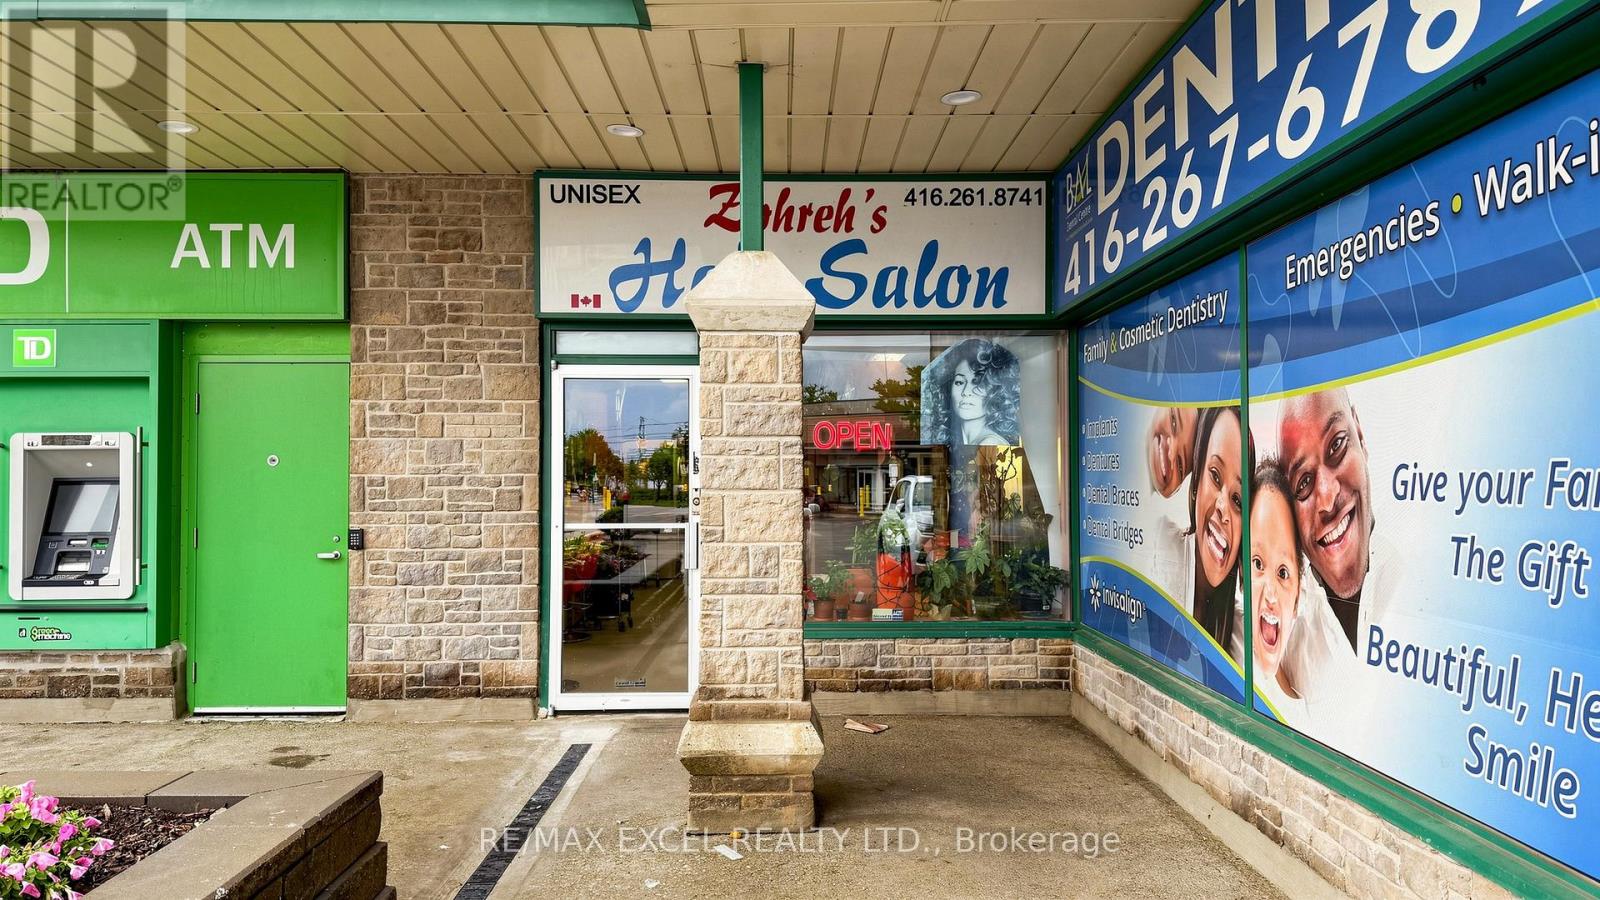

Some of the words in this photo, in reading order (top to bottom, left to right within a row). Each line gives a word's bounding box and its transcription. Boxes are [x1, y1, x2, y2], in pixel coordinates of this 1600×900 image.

[1064, 0, 1540, 296] 416-267-678
[550, 183, 641, 204] UNISEX
[904, 187, 1043, 206] 416.261.8741
[170, 223, 296, 269] ATM
[1285, 199, 1441, 291] Emergencies
[805, 238, 1009, 310] Salon
[17, 336, 52, 360] TD
[1083, 335, 1109, 363] Family
[1110, 332, 1117, 354] &
[1119, 312, 1164, 351] Cosmetic
[1167, 289, 1228, 333] Dentistry
[812, 420, 891, 450] OPEN
[1086, 452, 1120, 471] Dentures
[1086, 484, 1111, 506] Dental
[1112, 485, 1140, 507] Braces
[1392, 463, 1448, 502] Give
[1454, 470, 1534, 516] your
[1086, 516, 1111, 540] Dental
[1112, 517, 1144, 550] Bridges
[1450, 533, 1506, 584] The
[1516, 540, 1591, 608] Gift
[1365, 624, 1529, 724] Beautiful,
[1464, 724, 1580, 818] Smile
